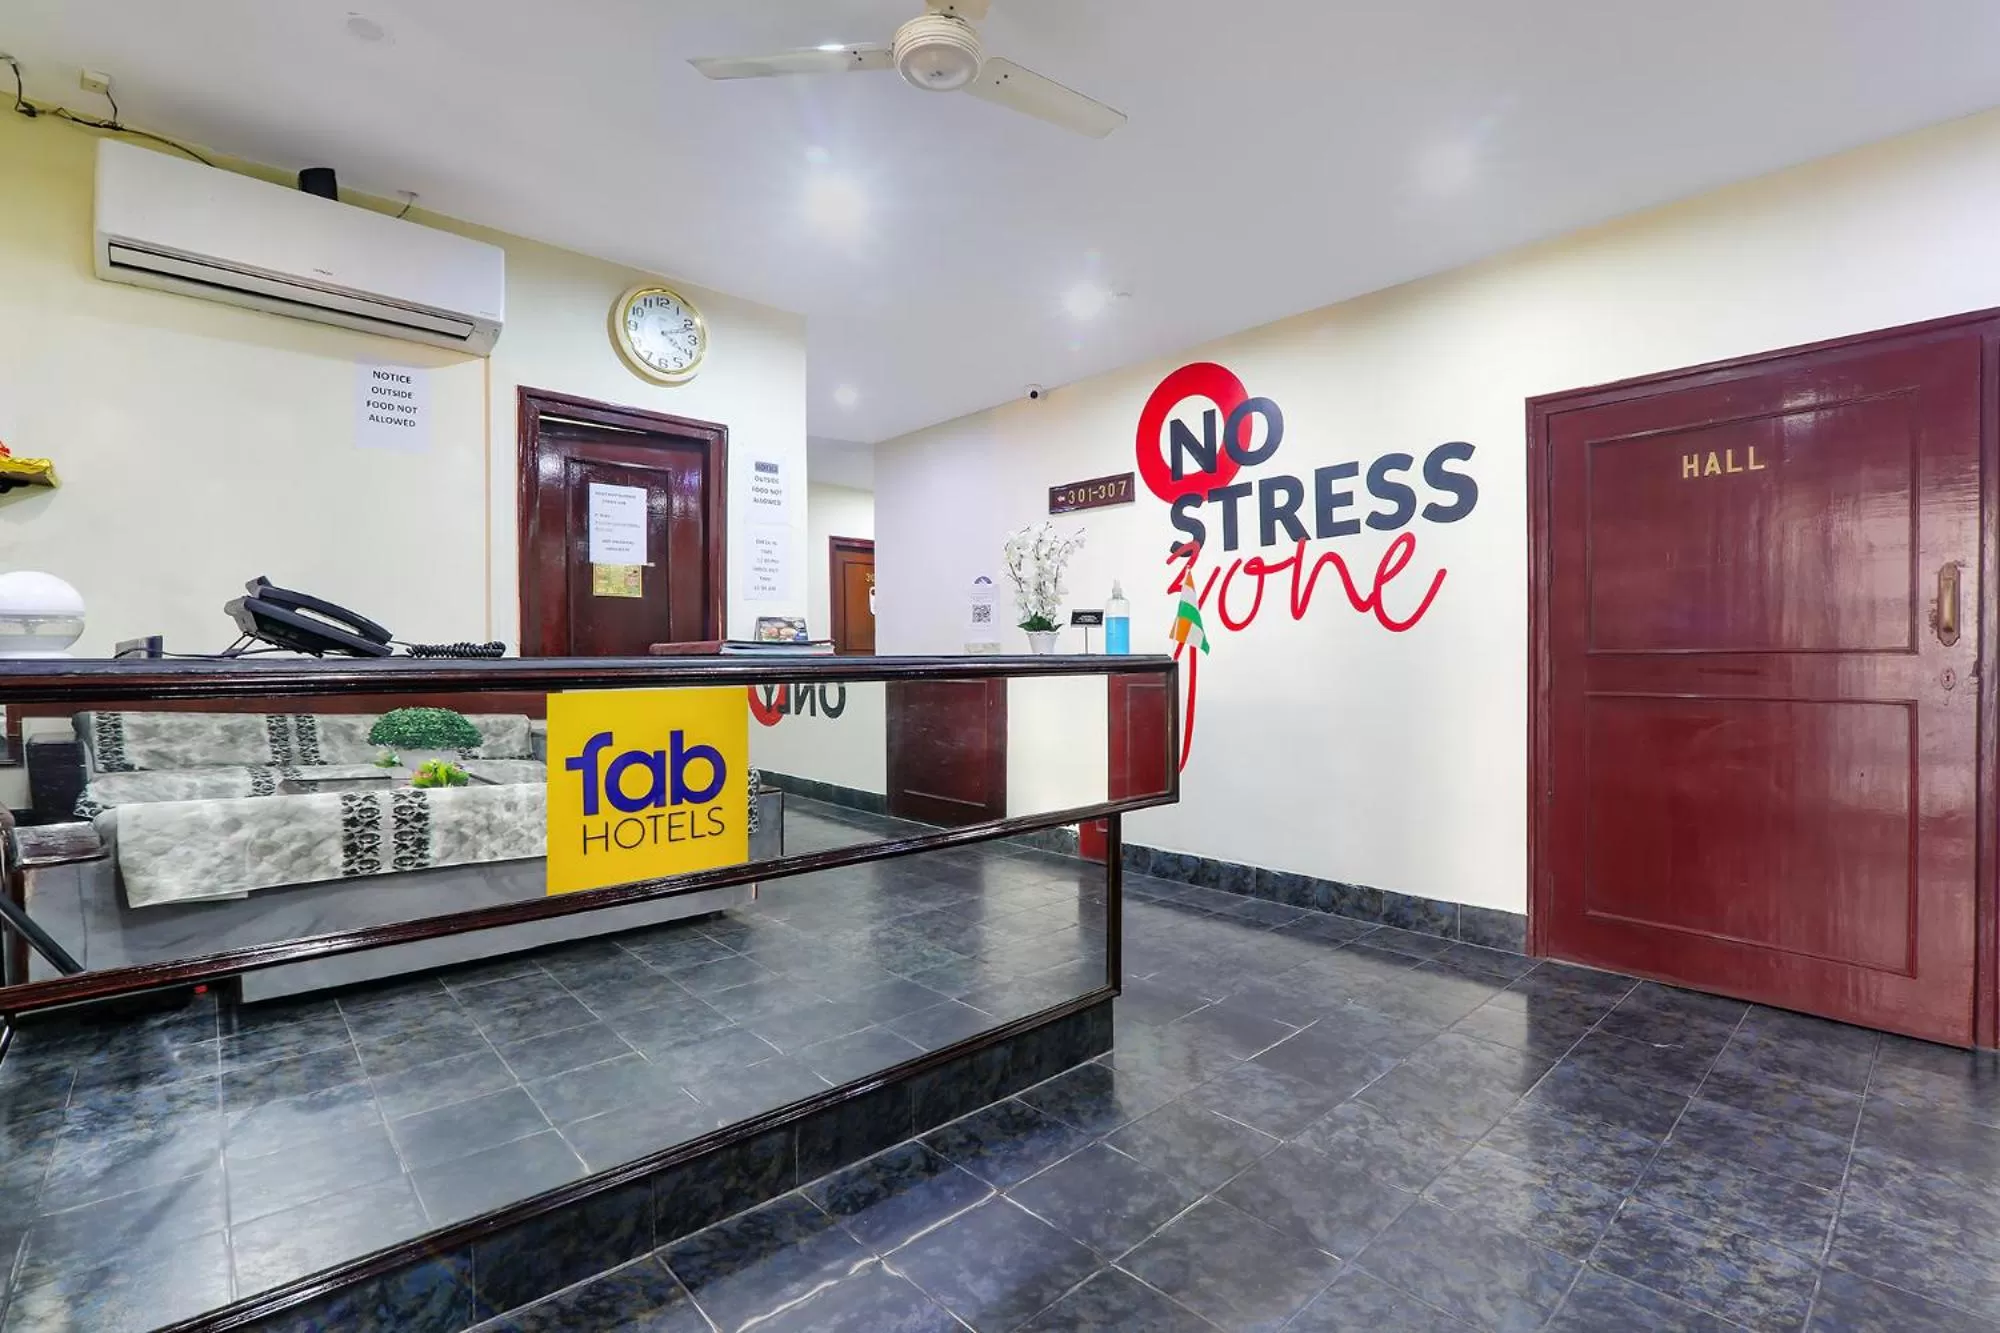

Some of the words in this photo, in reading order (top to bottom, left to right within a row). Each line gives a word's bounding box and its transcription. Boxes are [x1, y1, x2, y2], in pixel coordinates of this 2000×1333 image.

[643, 297, 653, 309] 11
[656, 296, 670, 310] 12
[632, 306, 645, 318] 10
[628, 320, 638, 331] 9
[683, 319, 693, 332] 2
[688, 334, 697, 346] 3
[643, 350, 653, 361] 7
[684, 348, 693, 359] 4
[658, 358, 668, 368] 6
[673, 356, 683, 368] 5
[372, 370, 412, 385] NOTICE
[371, 386, 413, 400] OUTSIDE
[366, 400, 395, 411] FOOD
[396, 404, 418, 415] NOT
[368, 414, 416, 427] ALLOWED
[1169, 396, 1284, 483] NO
[1682, 446, 1765, 479] HALL
[1068, 480, 1127, 504] 301-307
[1169, 441, 1479, 558] STRESS
[565, 730, 727, 816] fab
[583, 806, 725, 856] HOTELS
